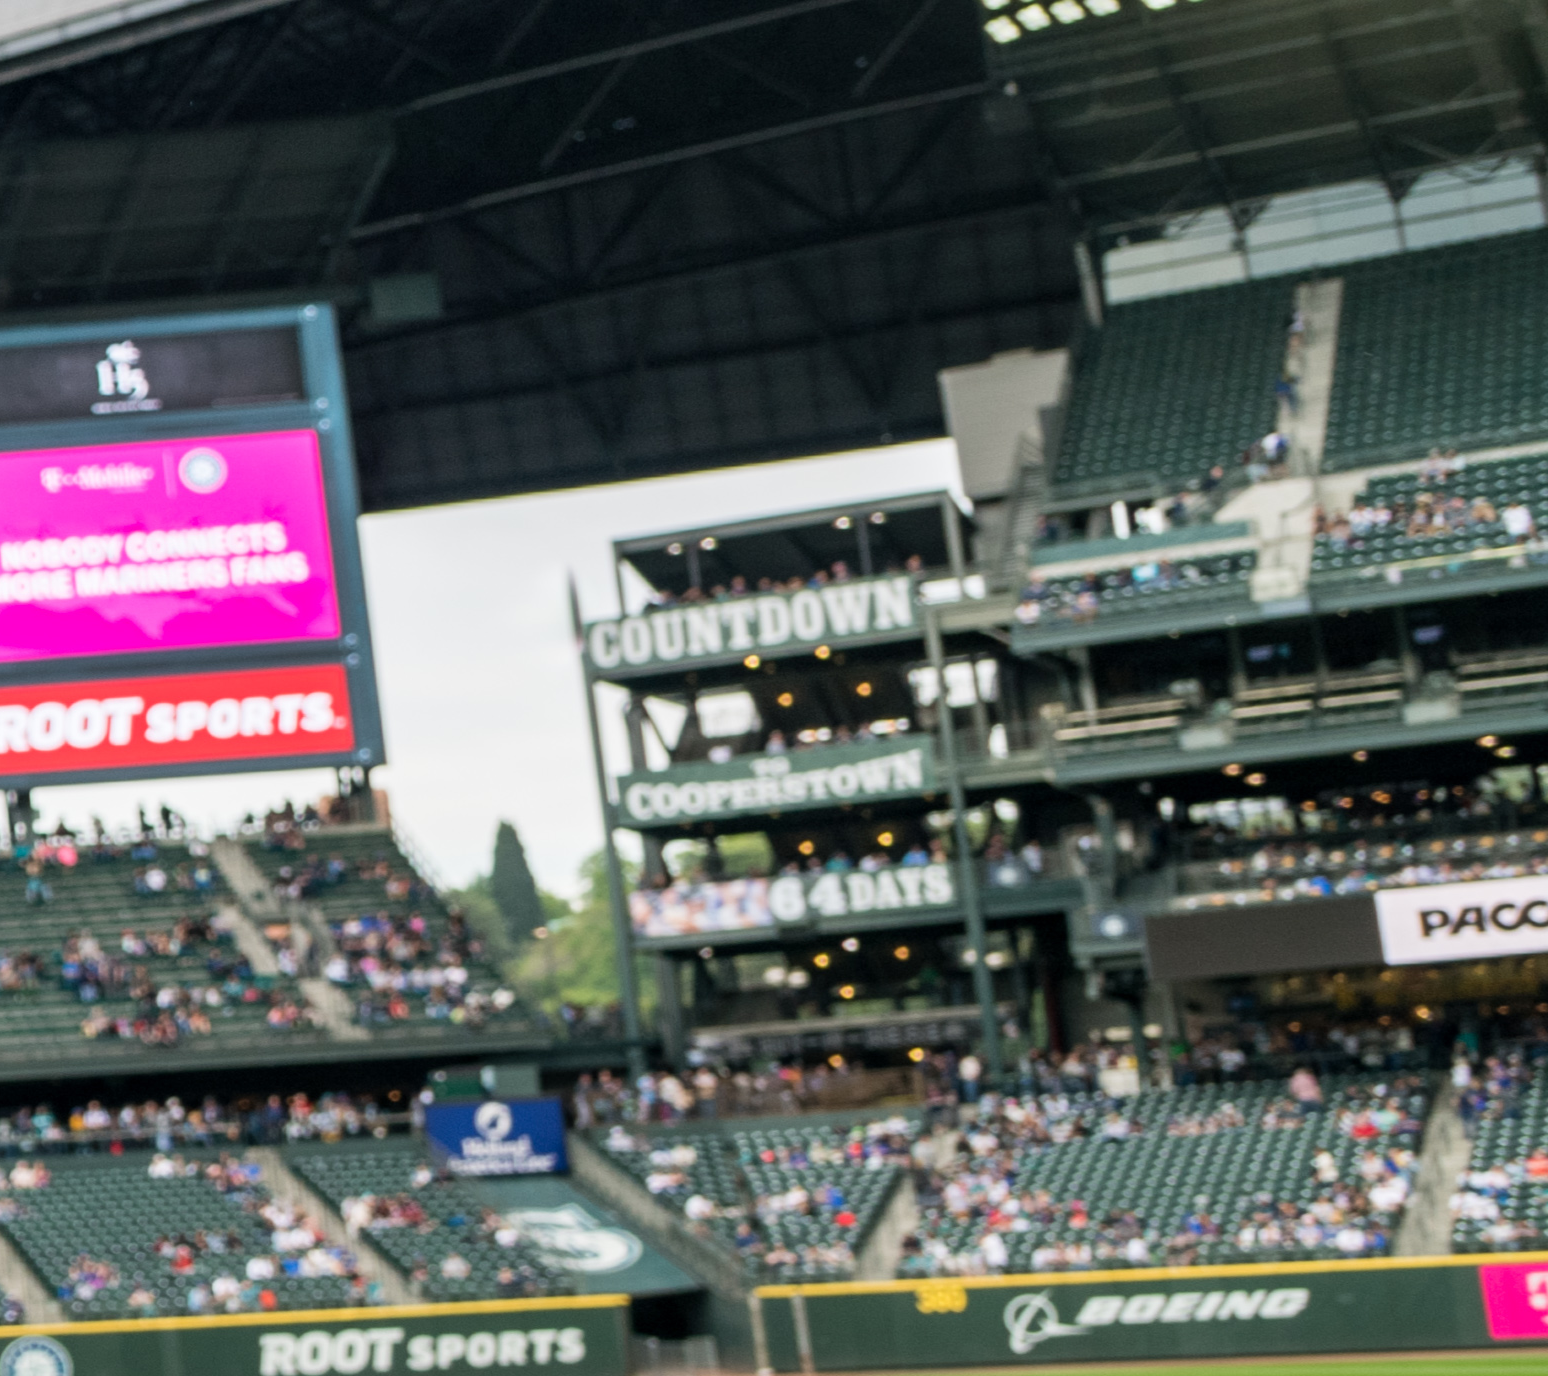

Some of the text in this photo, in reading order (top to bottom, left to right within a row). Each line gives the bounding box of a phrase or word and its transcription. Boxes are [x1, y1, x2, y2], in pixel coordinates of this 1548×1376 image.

[0, 521, 288, 571] NOBODY CONNECTS
[75, 557, 229, 597] MARINERS
[230, 551, 310, 586] FANS
[589, 576, 913, 668] COUNTDOWN
[145, 692, 336, 743] SPORTS
[626, 749, 923, 821] COOPERSTOWN
[847, 865, 953, 914] DAYS
[1073, 1288, 1310, 1324] BOEING
[406, 1328, 586, 1371] SPORTS
